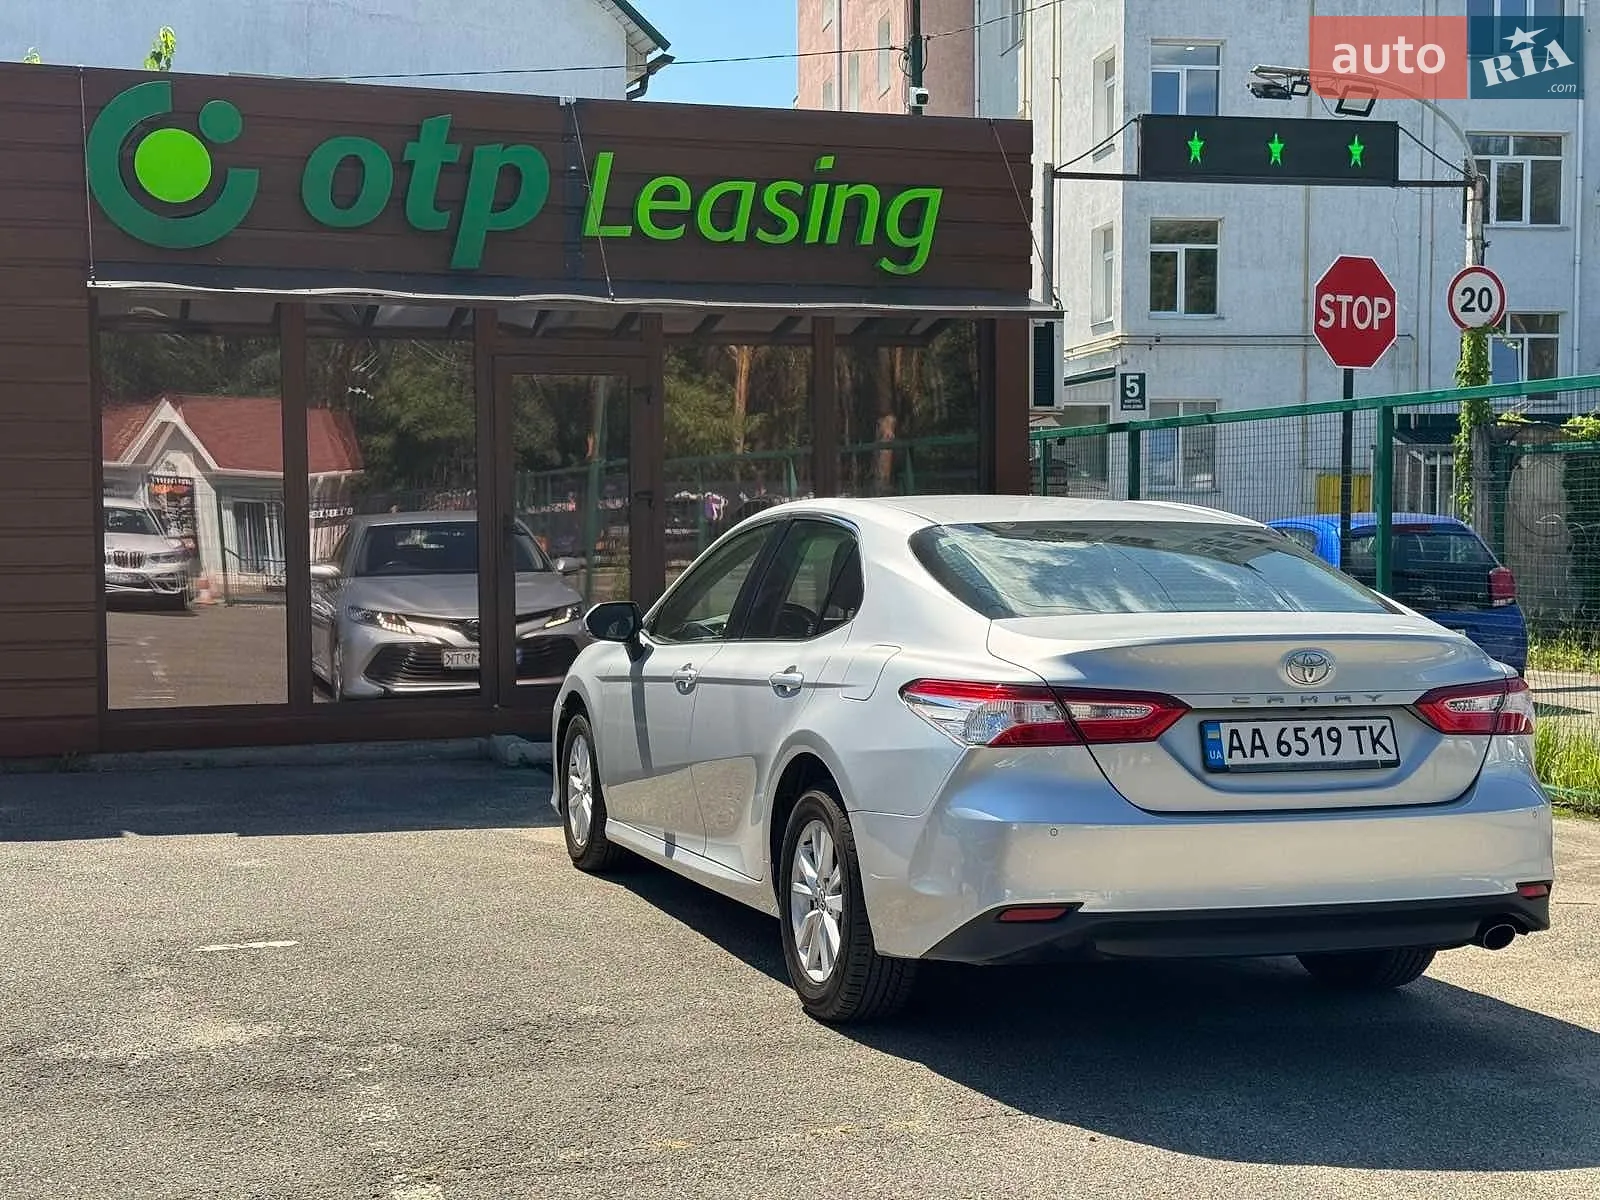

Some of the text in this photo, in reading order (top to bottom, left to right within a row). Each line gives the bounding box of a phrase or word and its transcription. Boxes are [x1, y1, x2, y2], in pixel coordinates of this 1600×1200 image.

[301, 114, 943, 276] otp Leasing
[1318, 293, 1392, 330] STOP
[1460, 287, 1493, 313] 20
[1126, 375, 1140, 398] 5
[1231, 694, 1383, 704] CAMRY
[1209, 749, 1224, 761] UA
[1227, 725, 1393, 759] AA 6519 TK
